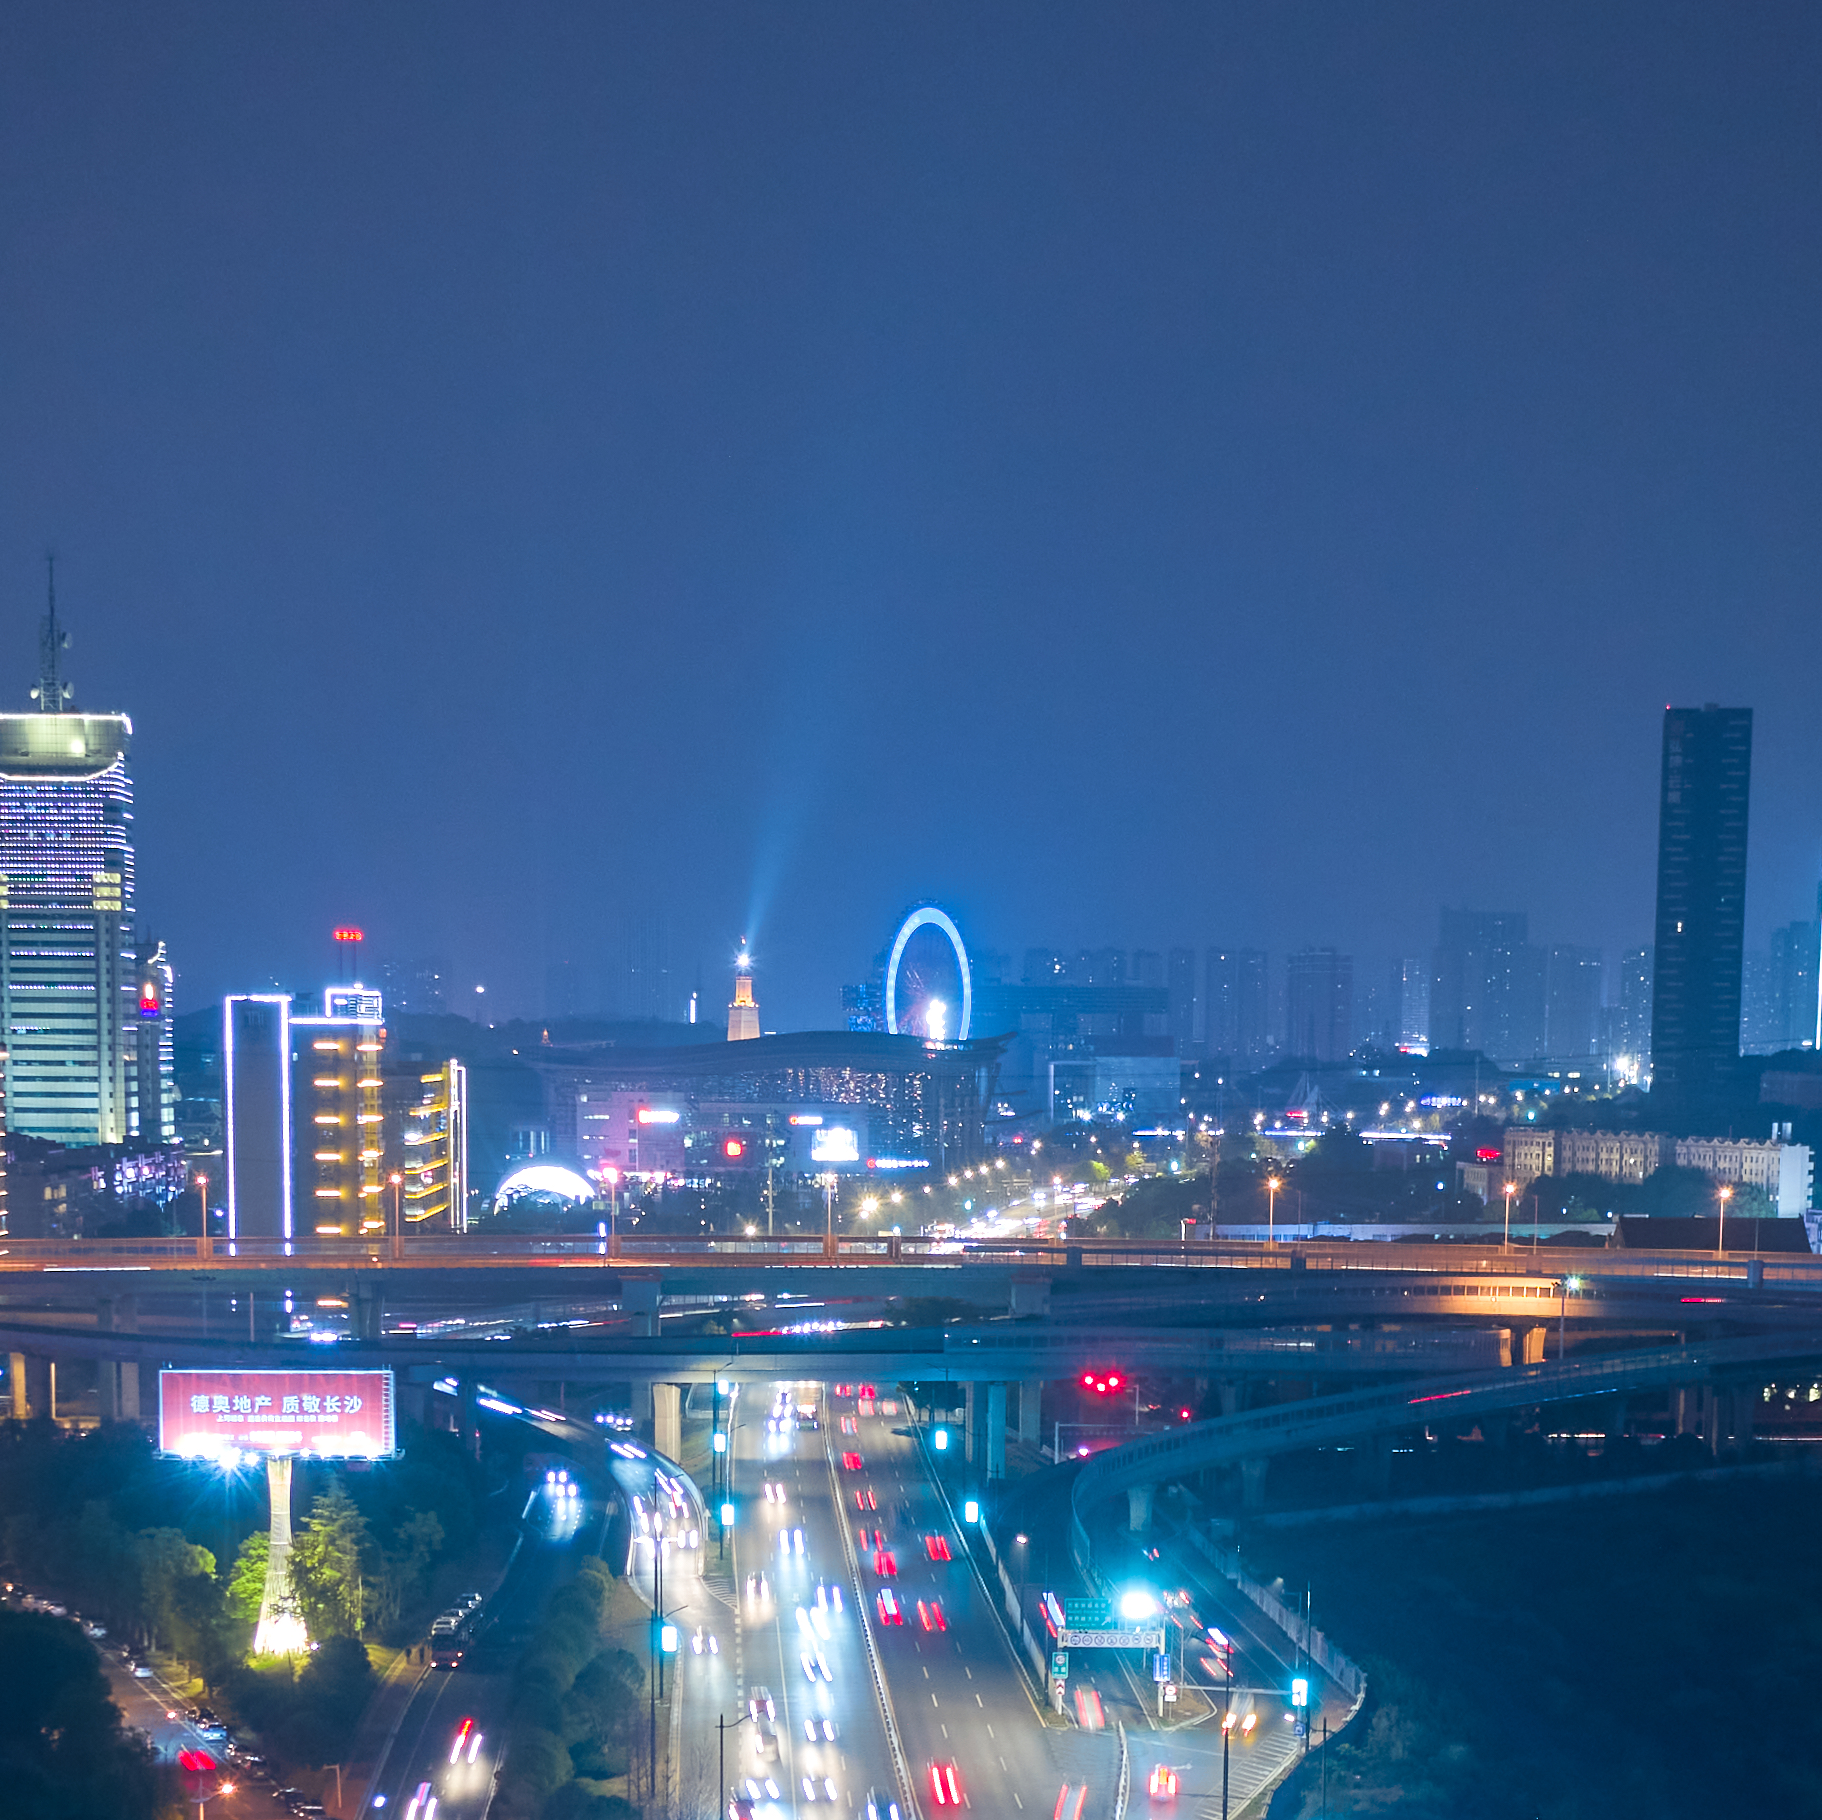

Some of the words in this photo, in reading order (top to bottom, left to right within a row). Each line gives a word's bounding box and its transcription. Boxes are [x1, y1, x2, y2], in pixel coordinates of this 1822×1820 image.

[190, 1394, 272, 1414] 德奥地产
[281, 1394, 363, 1414] 质敬长沙
